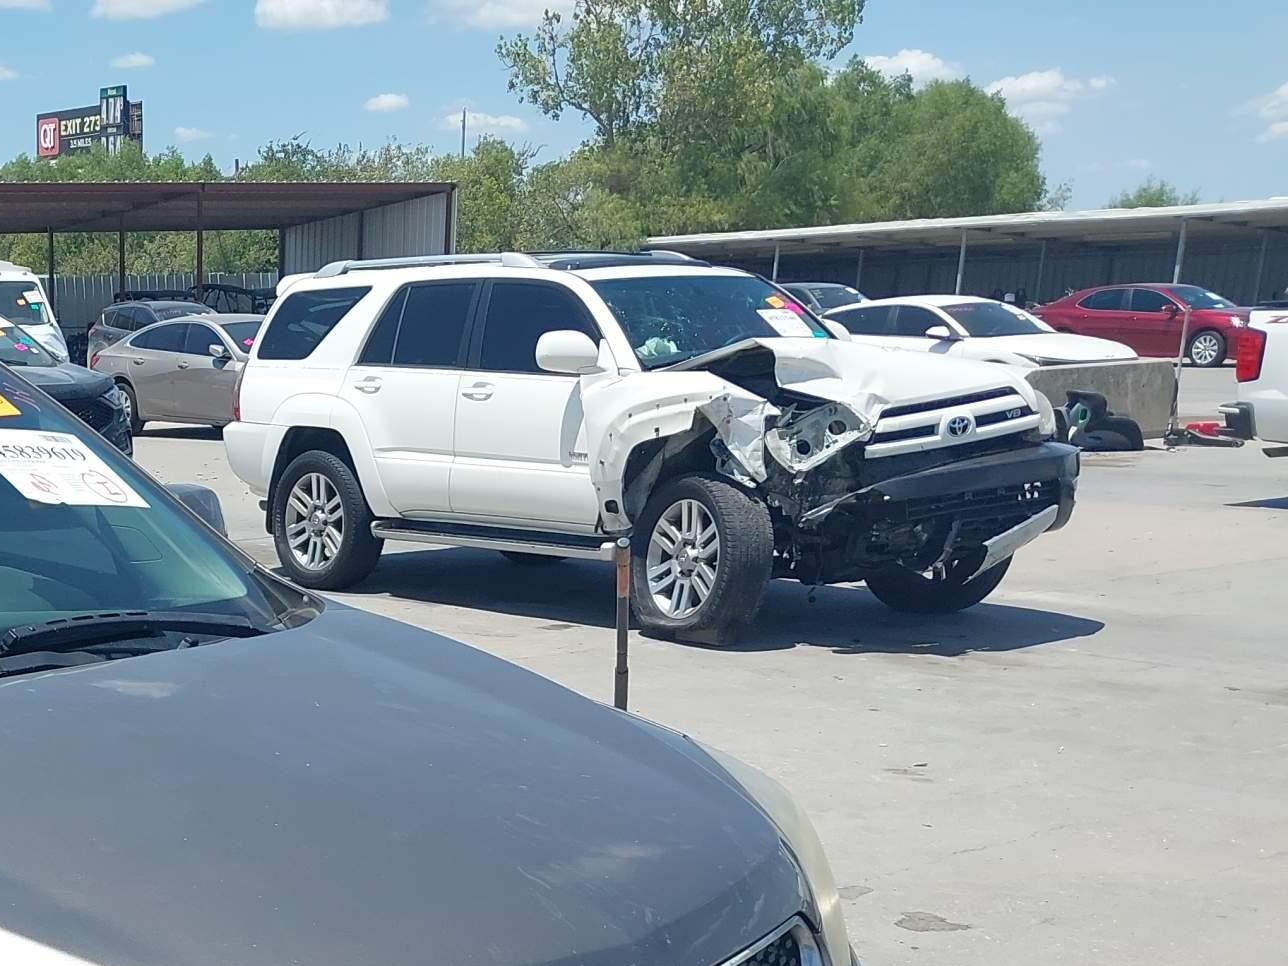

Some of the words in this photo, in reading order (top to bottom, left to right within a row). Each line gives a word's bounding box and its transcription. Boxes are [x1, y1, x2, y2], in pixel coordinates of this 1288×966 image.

[60, 118, 81, 135] EXIT
[84, 115, 100, 133] 273
[40, 123, 55, 148] QT
[78, 138, 92, 147] MILES
